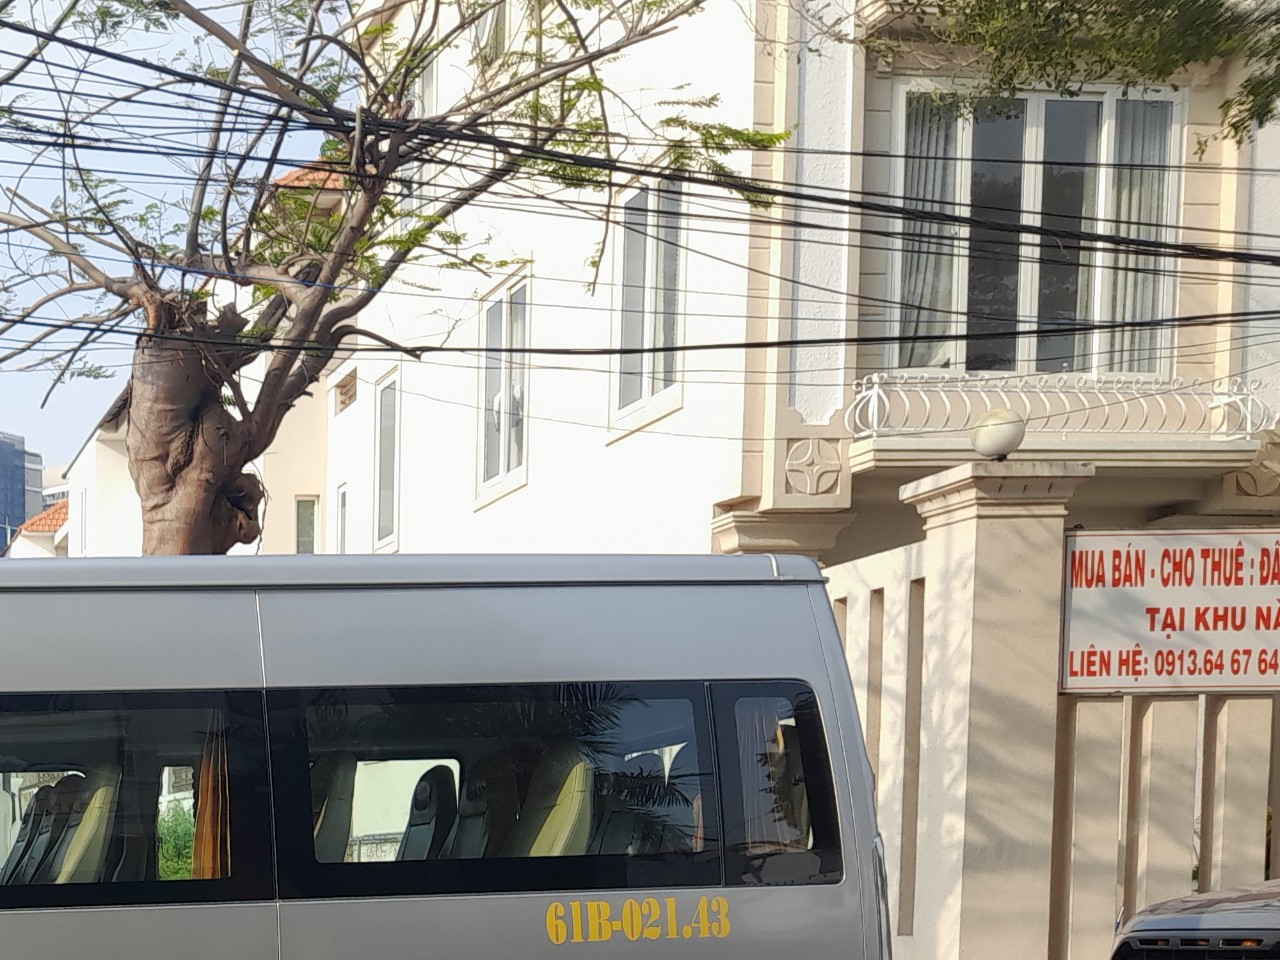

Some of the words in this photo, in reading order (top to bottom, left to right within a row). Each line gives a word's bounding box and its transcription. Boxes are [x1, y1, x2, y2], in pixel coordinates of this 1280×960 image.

[1071, 549, 1106, 588] MUA
[1111, 543, 1146, 588] BÁN
[1160, 548, 1195, 588] CHO
[1145, 606, 1185, 640] TẠI
[1194, 606, 1247, 631] KHU
[1069, 643, 1111, 677] LIÊN
[1117, 642, 1149, 682] HỆ:
[1154, 648, 1224, 676] 0913.64
[1230, 648, 1252, 675] 67
[1257, 648, 1279, 675] 64
[545, 895, 731, 945] 61B-021.43
